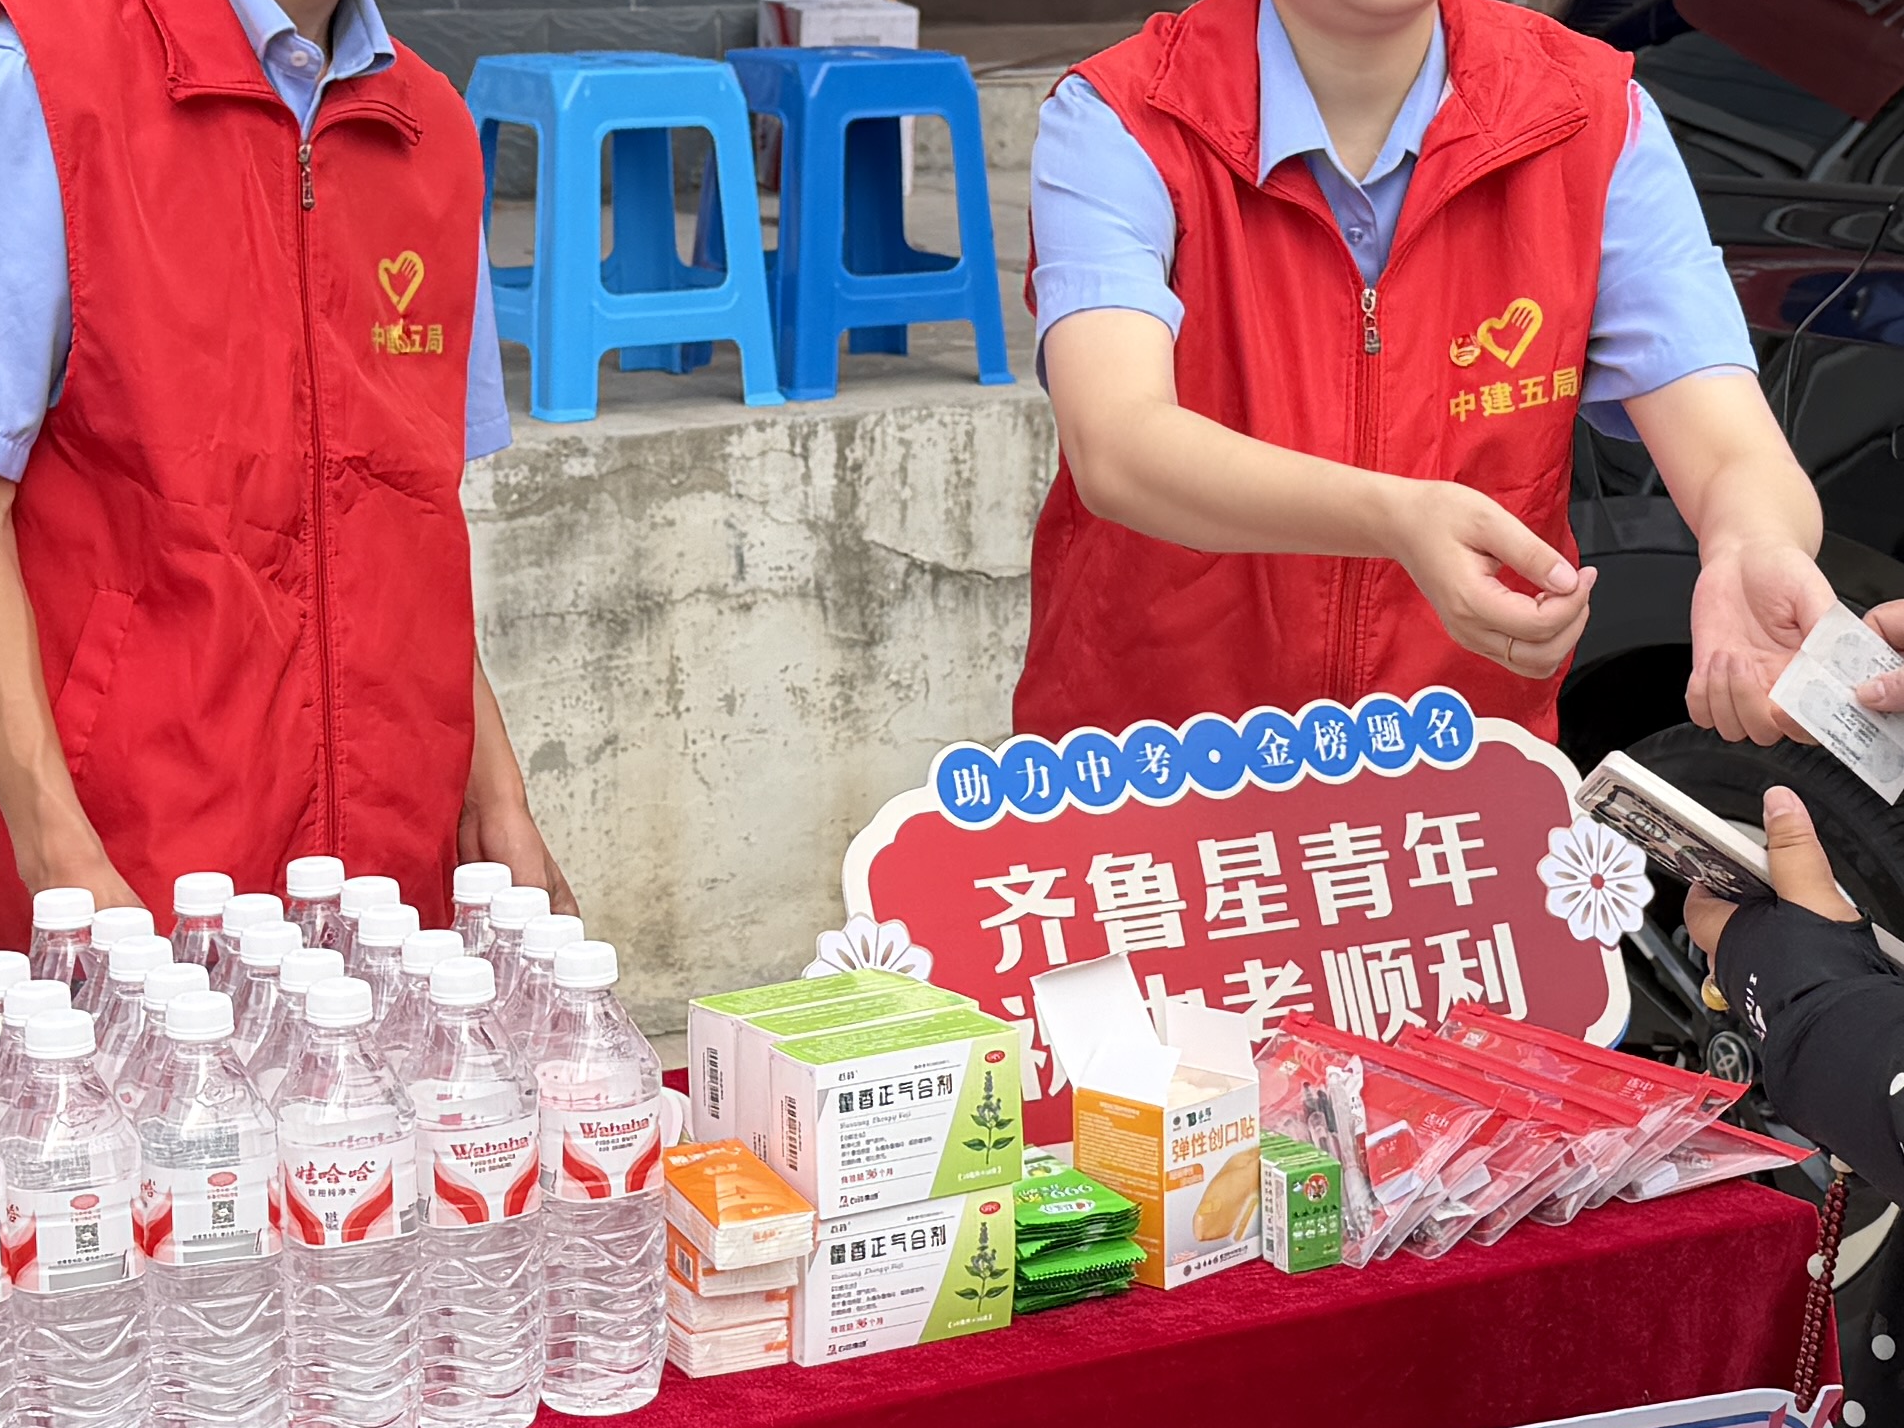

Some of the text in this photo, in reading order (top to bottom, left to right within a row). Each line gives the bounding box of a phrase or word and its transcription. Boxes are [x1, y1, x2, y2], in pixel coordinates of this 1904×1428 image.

[1450, 366, 1581, 422] 中建五局
[973, 811, 1499, 975] 齐鲁星青年
[580, 1117, 650, 1139] Wahaha
[1172, 1115, 1255, 1163] 弹性创口贴
[450, 1135, 530, 1161] Wahaha
[295, 1161, 375, 1184] 娃哈哈
